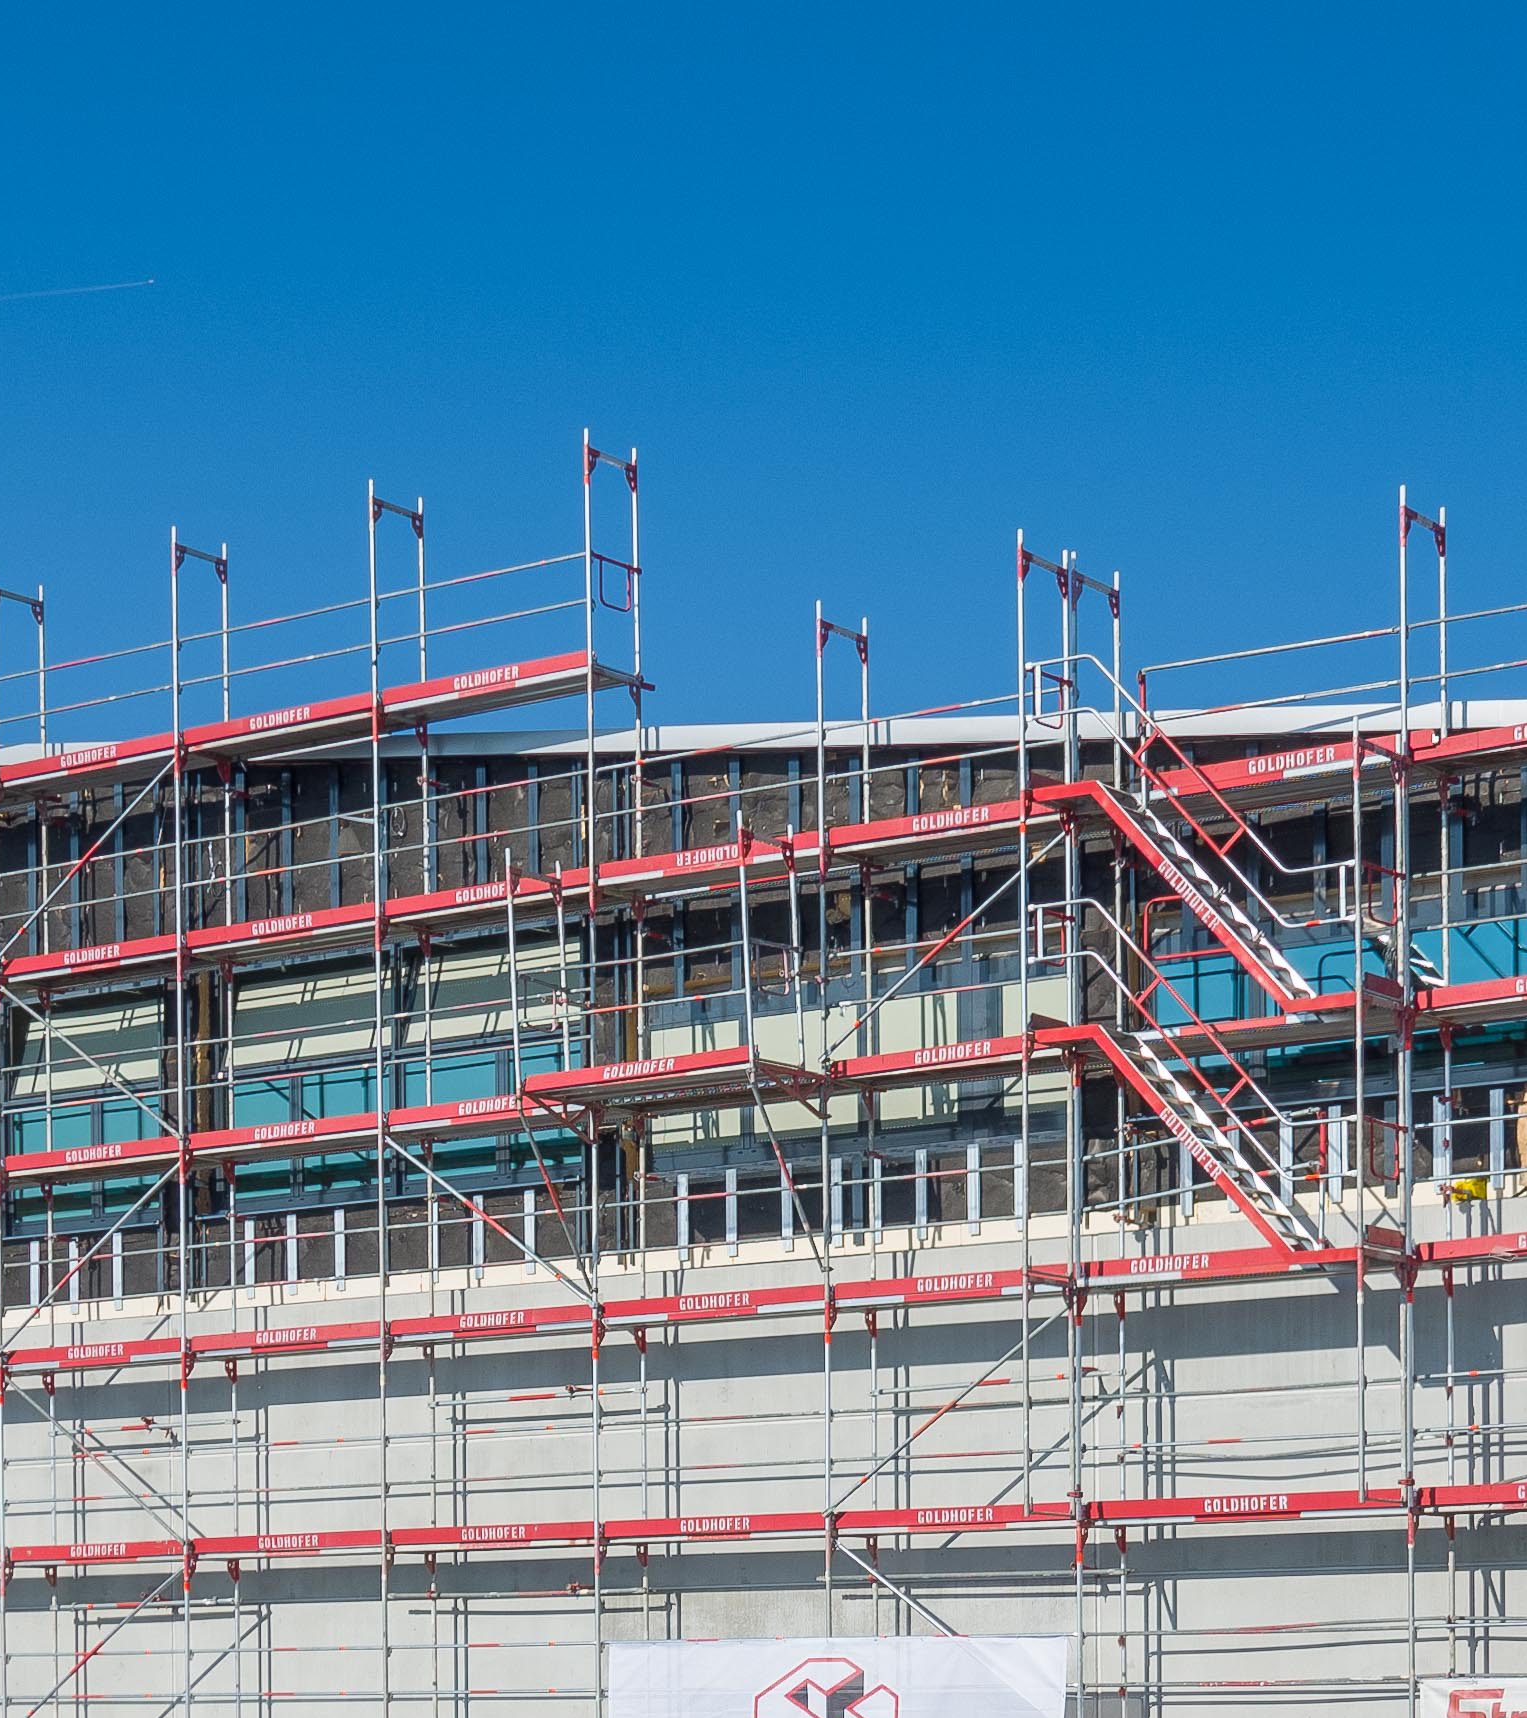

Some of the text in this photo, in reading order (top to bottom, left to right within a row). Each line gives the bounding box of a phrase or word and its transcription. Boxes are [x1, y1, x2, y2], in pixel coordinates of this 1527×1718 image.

[453, 665, 519, 689] GOLDHOFER
[249, 707, 310, 729] GOLDHOFER
[61, 745, 117, 768] GOLDHOFER
[1248, 748, 1335, 775] GOLDHOFER
[912, 808, 988, 830] GOLDHOFER
[456, 884, 505, 901] GOLDHOF
[1158, 860, 1219, 931] GOLDHOFER
[251, 915, 312, 935] GOLDHOFER
[64, 944, 120, 965] GOLDHOFER
[914, 1042, 991, 1065] GOLDHOFER
[603, 1059, 675, 1080] GOLDHOFER
[458, 1097, 516, 1113] GOLDHOFE
[254, 1121, 314, 1139] GOLDHOFER
[65, 1144, 121, 1160] GOLDHOFER
[1160, 1108, 1222, 1180] GOLDHOFER
[1130, 1255, 1208, 1273] GOLDHOFER
[917, 1275, 992, 1292] GOLDHOFER
[679, 1294, 751, 1310] GOLDHOFER
[459, 1312, 524, 1328] GOLDHOFER
[257, 1328, 317, 1344] GOLDHOFER
[67, 1345, 124, 1360] GOLDHOFER
[1204, 1496, 1288, 1512] GOLDHOFER
[917, 1509, 993, 1524] GOLDHOFER
[463, 1526, 526, 1541] GOLDHOFER
[681, 1518, 749, 1533] GOLDHOFER
[69, 1544, 126, 1557] GOLDHOFER
[259, 1535, 319, 1549] GOLDHOFER
